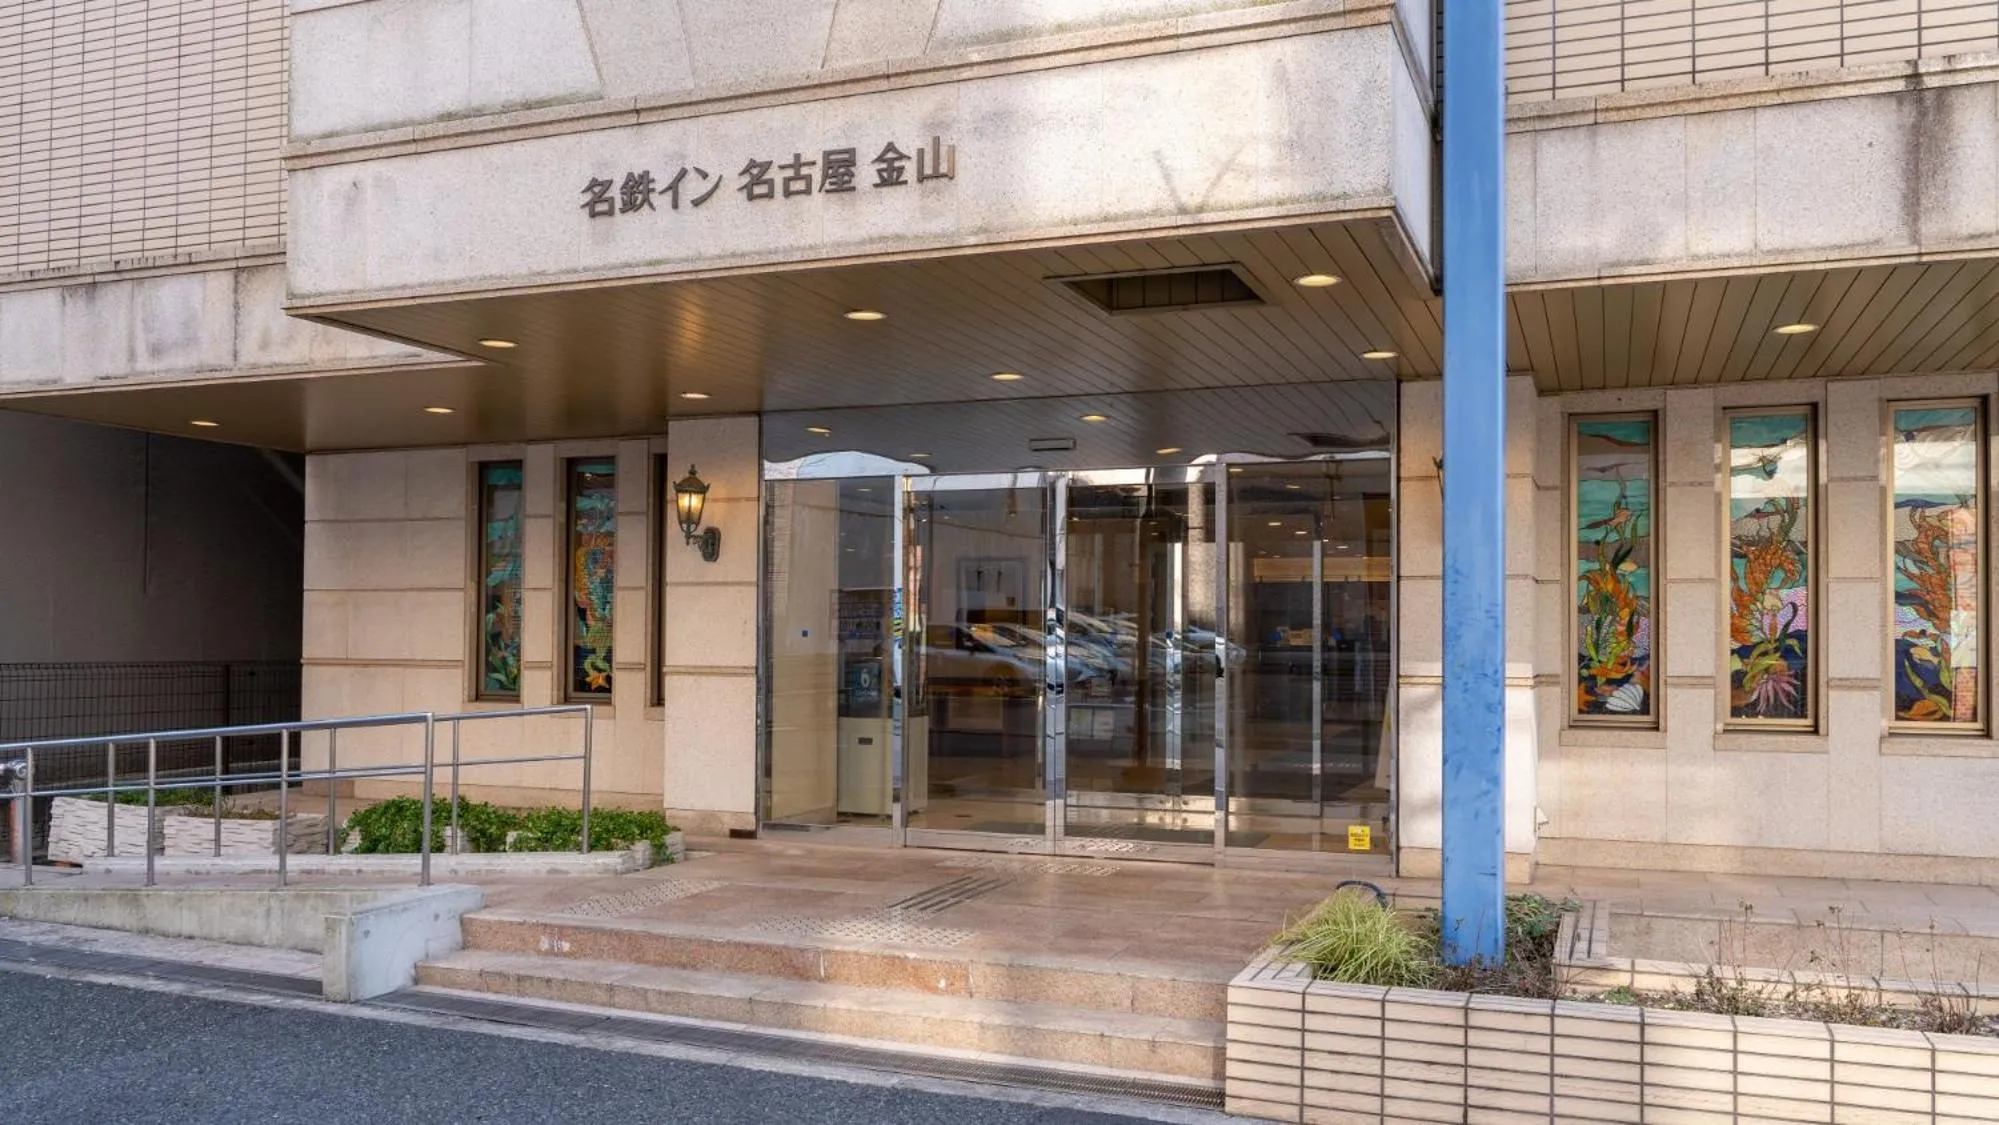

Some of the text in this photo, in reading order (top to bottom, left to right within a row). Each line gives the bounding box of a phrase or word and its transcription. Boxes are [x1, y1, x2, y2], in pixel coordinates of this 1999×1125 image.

[580, 135, 956, 218] 名鉄イン 名古屋 金山
